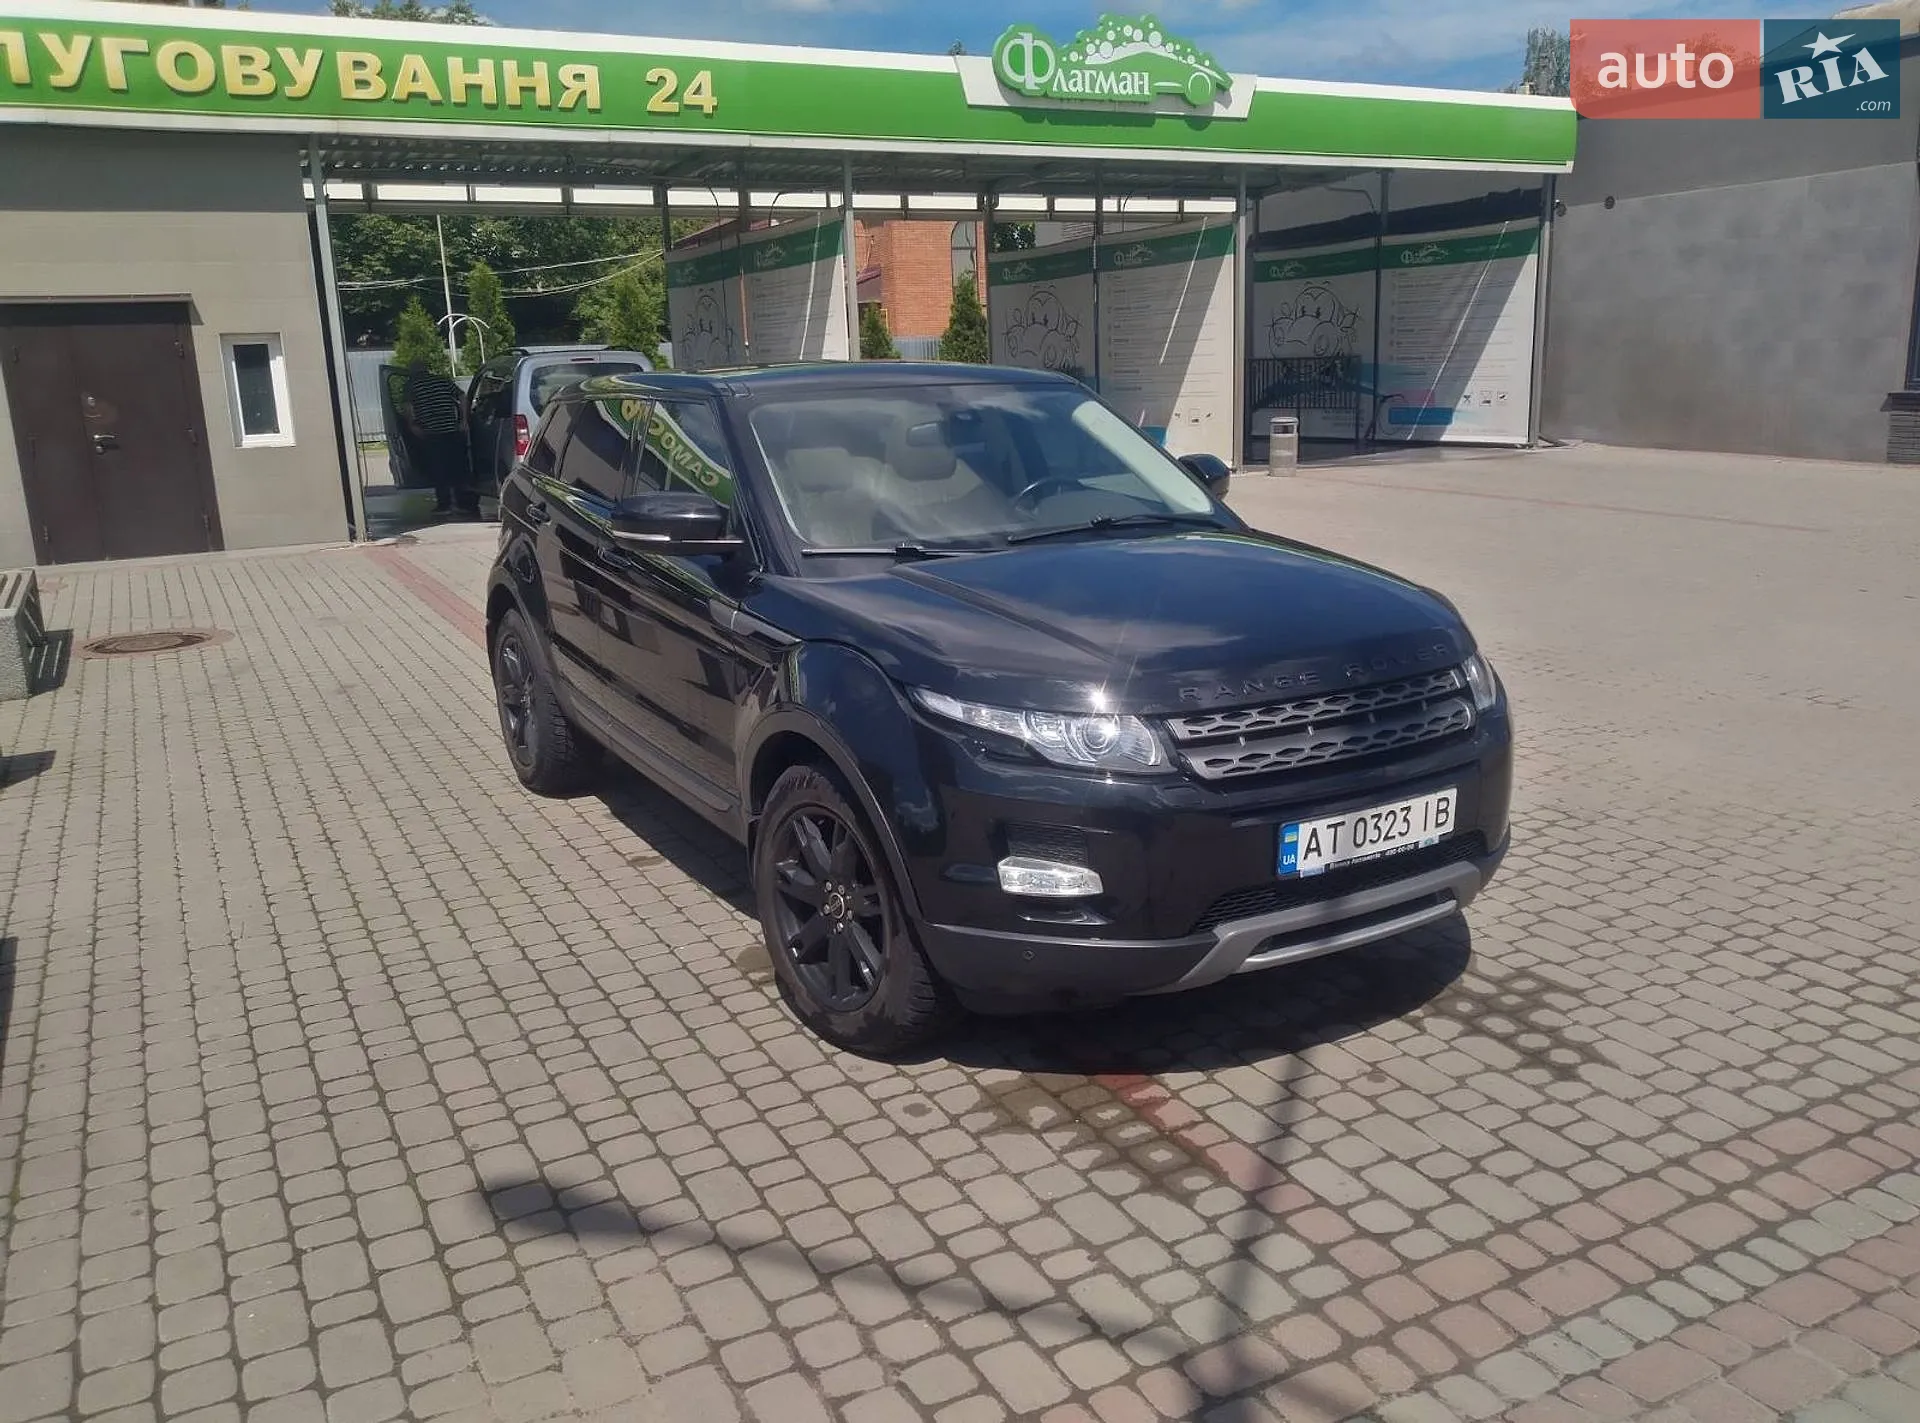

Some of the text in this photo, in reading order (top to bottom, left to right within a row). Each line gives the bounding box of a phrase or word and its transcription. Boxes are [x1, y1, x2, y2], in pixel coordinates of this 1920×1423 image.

[645, 67, 718, 114] 24
[1002, 31, 1151, 96] Флагман
[1178, 643, 1449, 702] RANGE ROVER
[1303, 820, 1346, 861] AT
[1353, 804, 1412, 849] 0323
[1423, 796, 1451, 833] IB
[1282, 854, 1297, 866] UA
